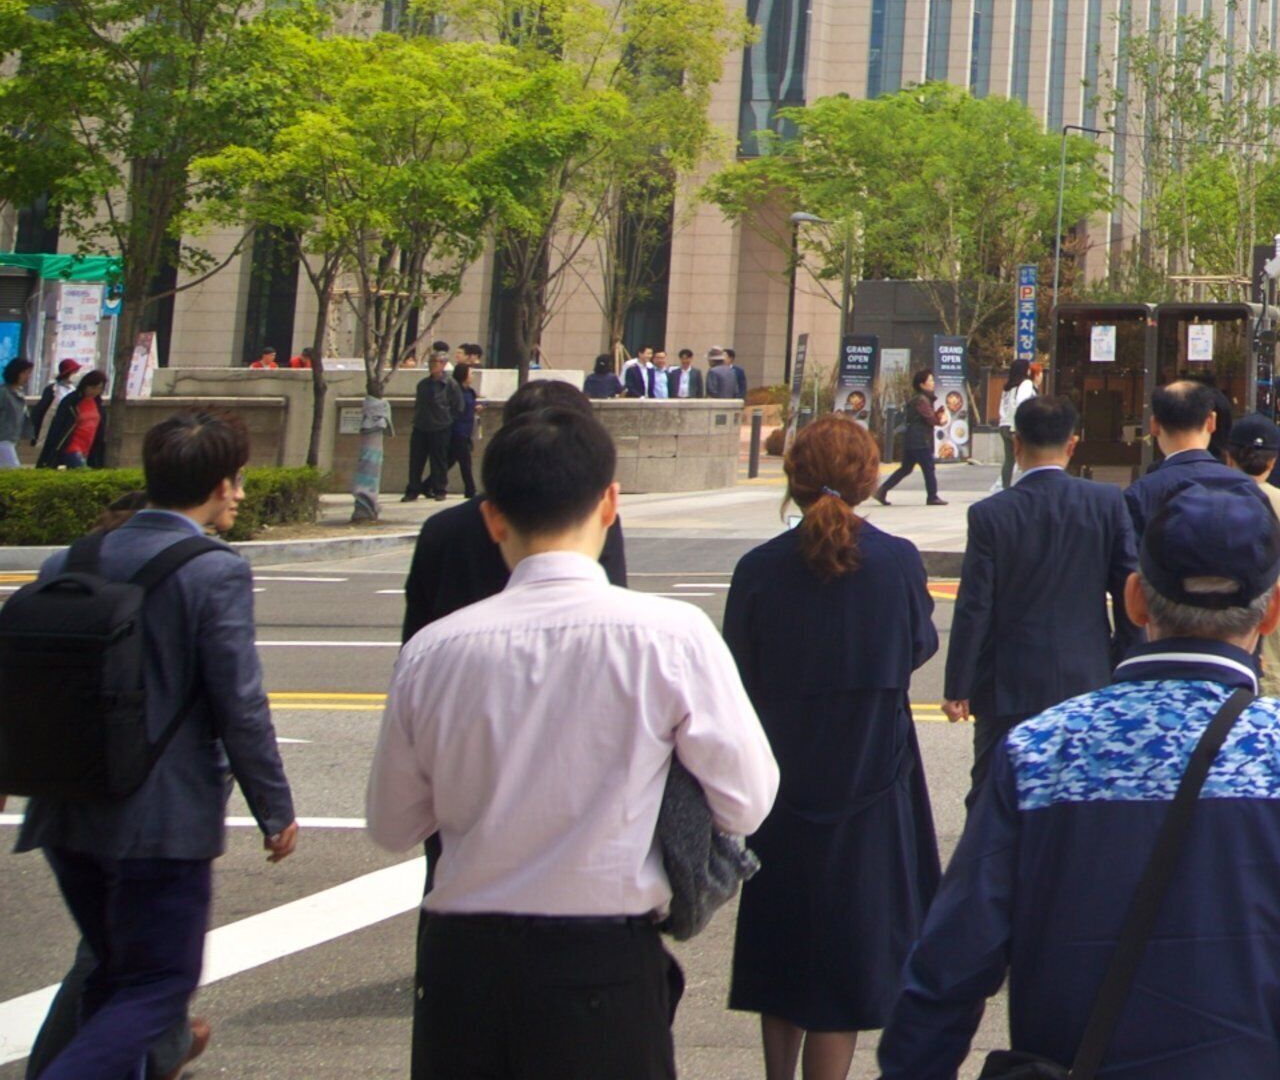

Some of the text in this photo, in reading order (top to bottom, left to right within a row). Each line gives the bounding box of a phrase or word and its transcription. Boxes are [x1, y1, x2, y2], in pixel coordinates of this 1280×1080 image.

[1022, 287, 1033, 299] P
[1020, 301, 1034, 350] 주차장
[846, 345, 873, 354] GRAND
[938, 345, 963, 354] GRAND
[847, 355, 869, 363] OPEN
[941, 355, 961, 364] OPEN
